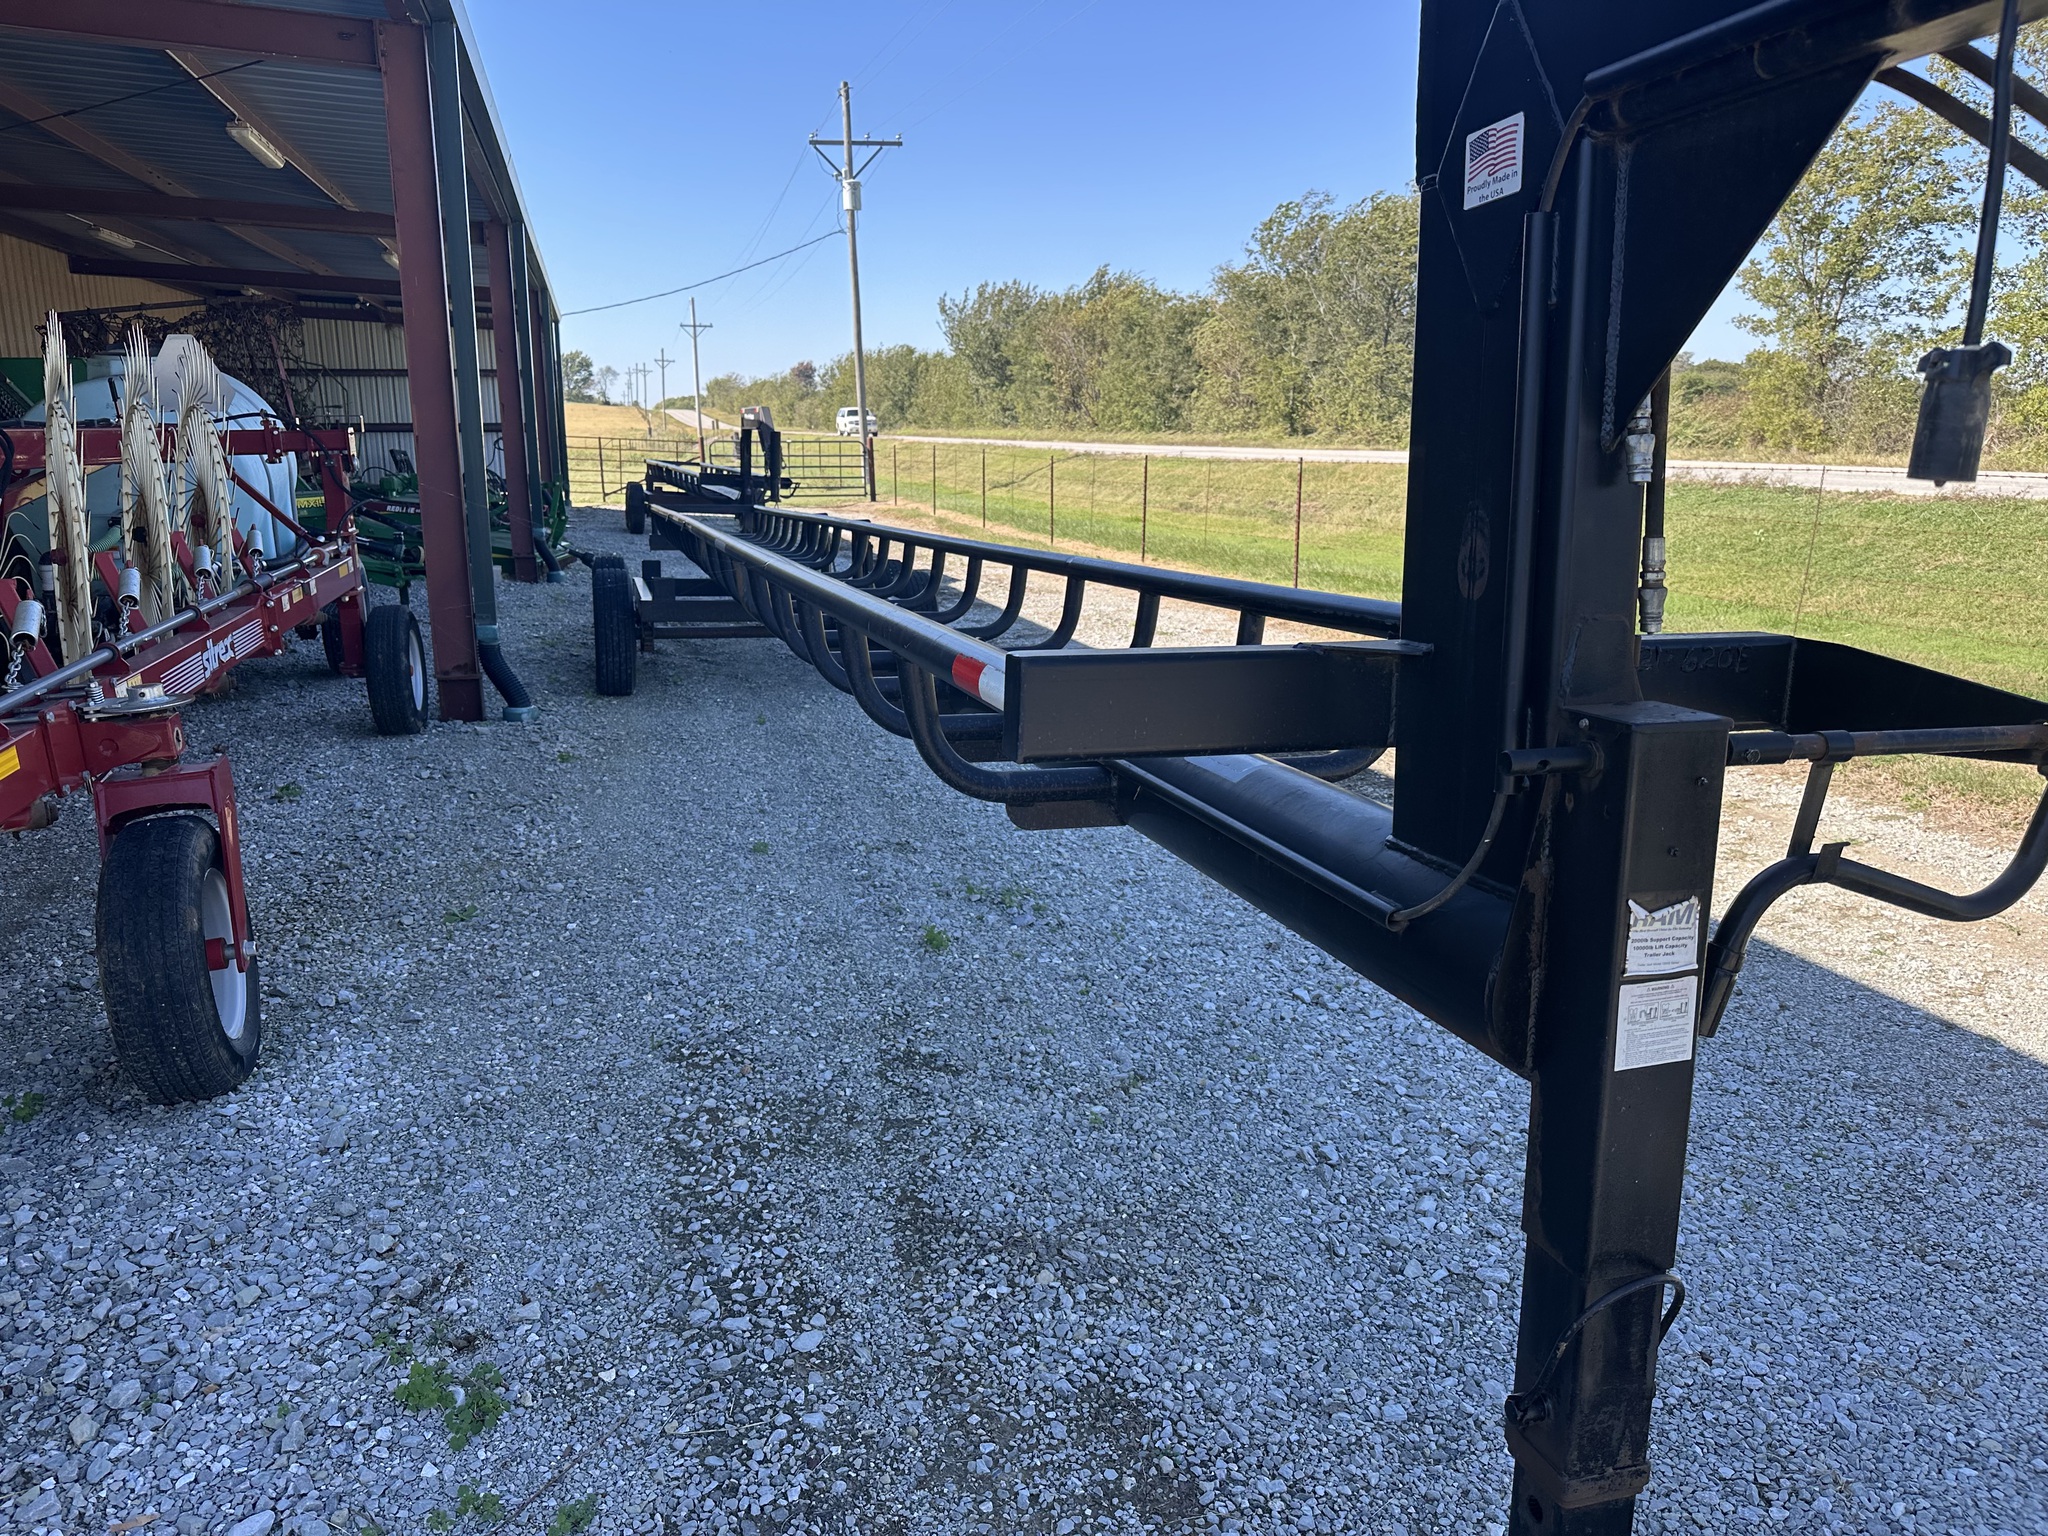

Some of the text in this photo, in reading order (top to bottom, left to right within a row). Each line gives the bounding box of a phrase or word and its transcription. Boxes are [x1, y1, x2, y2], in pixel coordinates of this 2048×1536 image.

[1467, 170, 1518, 195] Proudly Made in
[1479, 188, 1504, 203] the USA
[202, 633, 235, 679] sitrex
